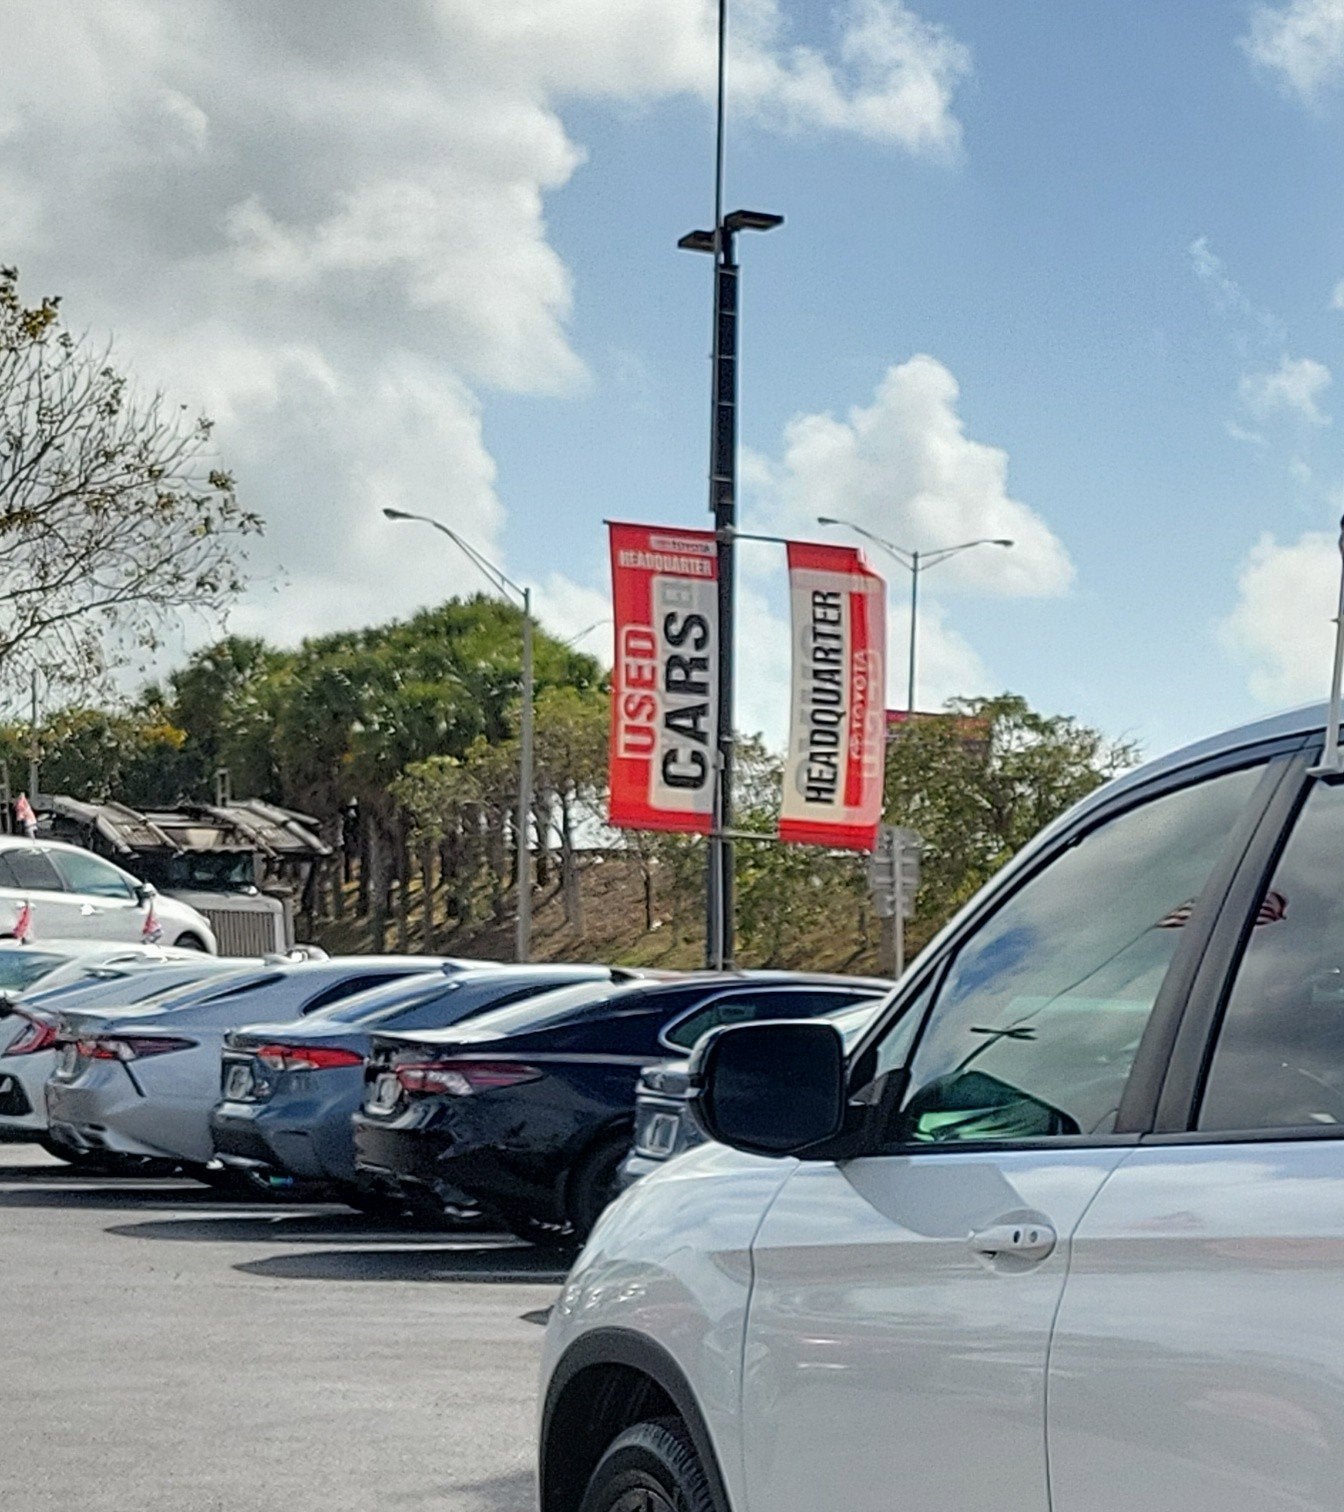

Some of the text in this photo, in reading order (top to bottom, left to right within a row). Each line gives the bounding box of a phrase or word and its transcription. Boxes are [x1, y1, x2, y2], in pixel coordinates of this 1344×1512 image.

[618, 550, 712, 576] HEADQUARTER
[618, 625, 656, 759] USED
[662, 612, 710, 789] CARS
[805, 590, 846, 804] HEADQUARTER
[851, 650, 868, 729] TOYOTA
